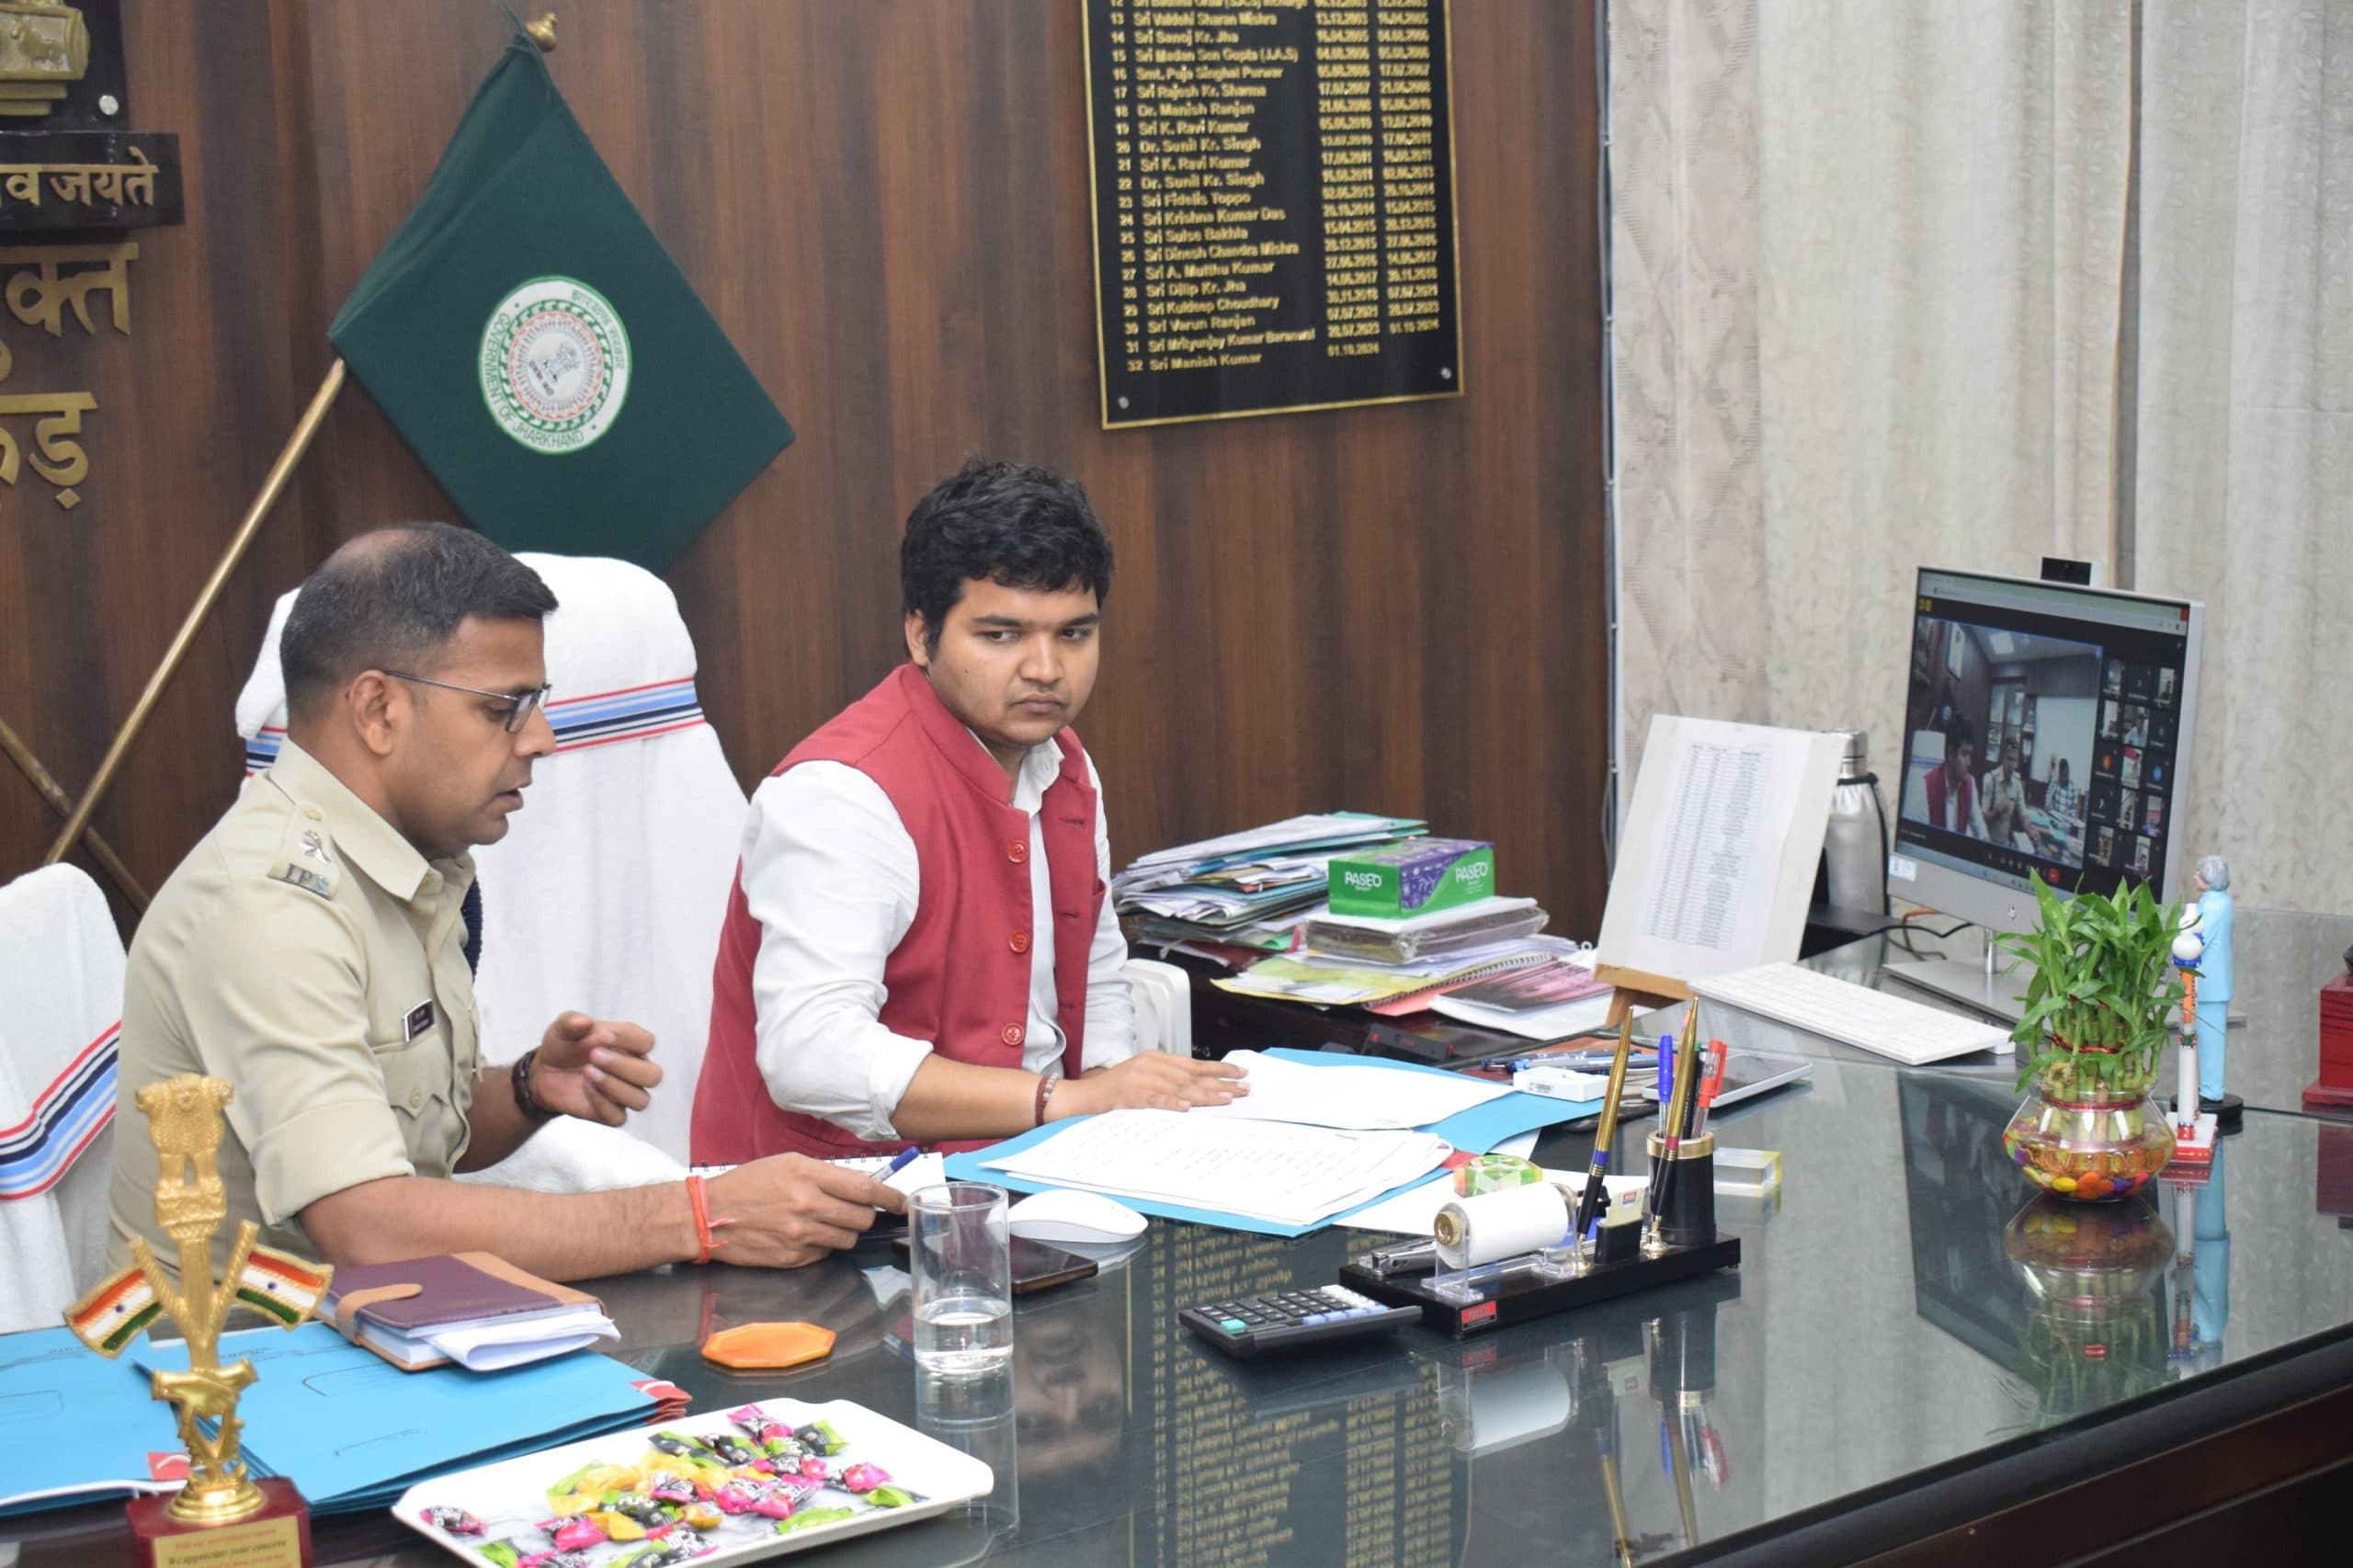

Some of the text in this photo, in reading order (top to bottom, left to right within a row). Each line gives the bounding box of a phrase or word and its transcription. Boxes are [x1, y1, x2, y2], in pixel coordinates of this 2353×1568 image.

[1110, 12, 1124, 25] 13
[1133, 11, 1151, 26] Sri
[1197, 12, 1238, 26] Sharan
[1111, 31, 1125, 43] 14
[1134, 28, 1154, 44] Sri
[1194, 30, 1213, 43] Kr.
[1215, 30, 1239, 43] Jha
[1112, 49, 1126, 62] 15
[1135, 47, 1154, 62] Sri
[1198, 49, 1221, 61] Sen
[1222, 48, 1258, 62] Gupta
[1113, 68, 1127, 80] 16
[1165, 64, 1194, 84] Puja
[1114, 85, 1127, 99] 17
[1137, 84, 1155, 98] Sri
[1157, 84, 1199, 100] Rajesh
[1201, 85, 1220, 97] Kr.
[1221, 84, 1267, 97] Sharma
[1115, 105, 1129, 118] 18
[1137, 104, 1157, 117] Dr.
[1159, 102, 1207, 116] Manish
[1210, 101, 1255, 117] Ranjan
[1116, 122, 1130, 135] 19
[1139, 120, 1157, 135] Sri
[1160, 121, 1175, 135] K.
[1176, 119, 1205, 134] Ravi
[1208, 120, 1249, 133] Kumar
[1116, 141, 1131, 153] 20
[1139, 141, 1160, 153] Dr.
[1163, 138, 1197, 153] Sunil
[1200, 138, 1220, 151] Kr.
[1222, 136, 1261, 153] Singh
[1118, 158, 1131, 171] 21
[1141, 156, 1159, 172] Sri
[1162, 157, 1176, 171] K.
[1178, 155, 1207, 170] Ravi
[1209, 156, 1251, 169] Kumar
[50, 146, 159, 207] जयते
[1118, 177, 1132, 190] 22
[1141, 176, 1162, 189] Dr.
[1165, 174, 1199, 188] Sunil
[1203, 175, 1222, 187] Kr.
[1226, 172, 1265, 187] Singh
[1119, 196, 1132, 208] 23
[1142, 193, 1161, 207] Sri
[1164, 191, 1208, 206] Fidelis
[1211, 192, 1251, 206] Toppo
[1120, 213, 1133, 226] 24
[1142, 210, 1162, 226] Sri
[1165, 210, 1214, 224] Krishna
[1217, 210, 1259, 222] Kumar
[1261, 207, 1285, 221] Das
[1120, 232, 1135, 244] 25
[1143, 229, 1163, 244] Sri
[1121, 250, 1135, 262] 26
[1144, 246, 1162, 262] Sri
[1165, 246, 1207, 260] Dinesh
[1209, 245, 1258, 257] Chandra
[1260, 242, 1299, 256] Mishra
[1122, 268, 1136, 280] 27
[1145, 265, 1164, 280] Sri
[1166, 266, 1181, 278] A.
[1232, 262, 1274, 274] Kumar
[1123, 287, 1137, 299] 28
[1146, 283, 1165, 297] Sri
[1168, 283, 1199, 296] Dilip
[1201, 281, 1221, 294] Kr.
[1223, 280, 1246, 292] Jha
[1124, 304, 1138, 316] 29
[1147, 302, 1165, 315] Sri
[1166, 301, 1214, 313] Kuldeep
[1217, 297, 1279, 310] Choudhary
[1125, 323, 1139, 335] 30
[1148, 320, 1166, 334] Sri
[1170, 320, 1207, 331] Varun
[1211, 314, 1255, 329] Ranjan
[1127, 341, 1139, 353] 31
[1149, 338, 1165, 352] Sri
[1227, 334, 1266, 346] Kumar
[1128, 360, 1142, 371] 32
[1150, 358, 1168, 370] Sri
[1171, 357, 1217, 369] Manish
[1221, 355, 1261, 365] Kumar
[484, 313, 511, 405] GOVERNMENT
[499, 405, 516, 422] OF
[512, 422, 585, 449] JHARKHAND
[1345, 871, 1382, 888] PASEO
[1455, 861, 1489, 882] PASEO
